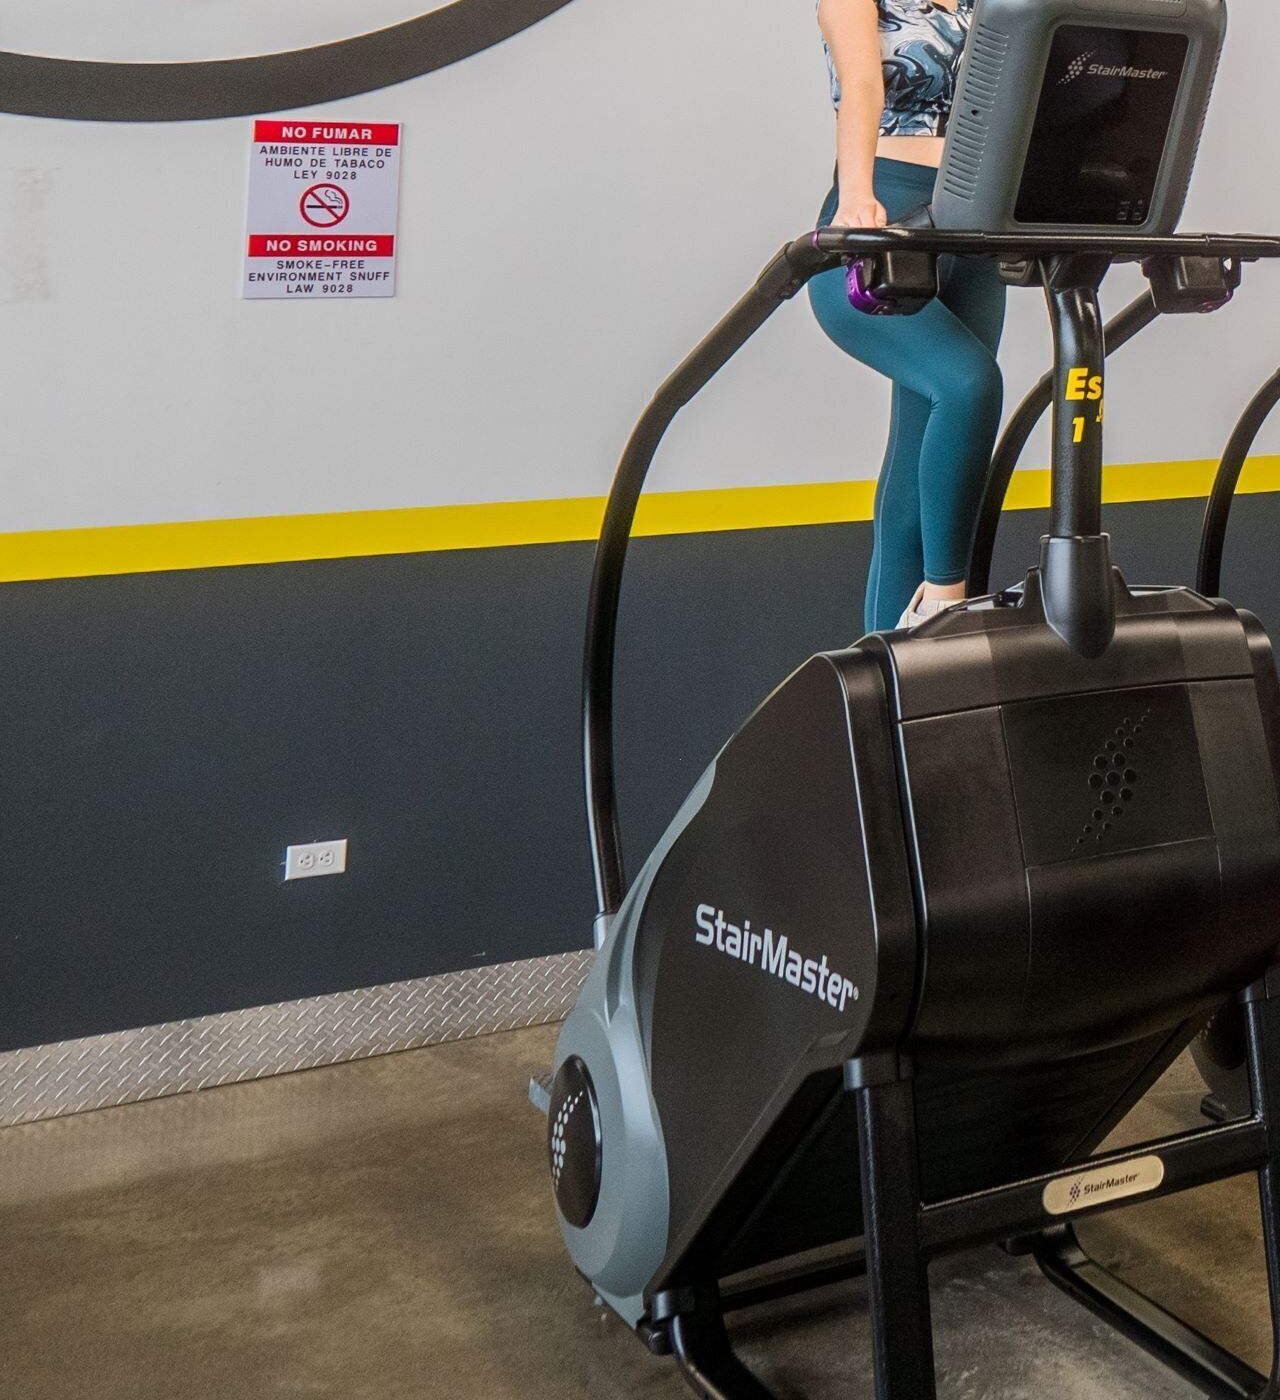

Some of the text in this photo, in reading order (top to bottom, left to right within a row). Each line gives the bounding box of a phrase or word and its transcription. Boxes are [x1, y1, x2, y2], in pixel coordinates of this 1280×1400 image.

[1087, 63, 1164, 80] StairMaster
[281, 126, 372, 140] NO FUMAR
[259, 145, 392, 157] AMBIENTE LIBRE DE
[265, 157, 385, 169] HUMO DE TABACO
[293, 170, 357, 180] LEY 9028
[266, 240, 378, 252] NO SMOKING
[276, 260, 365, 270] SMOKE-FREE
[248, 271, 390, 282] ENVIRONMENT SNUFF
[286, 284, 353, 293] LAW 9028
[1065, 367, 1102, 401] Es
[1072, 416, 1085, 443] 1
[696, 903, 854, 1012] StairMaster
[1084, 1174, 1139, 1195] StairMaster
